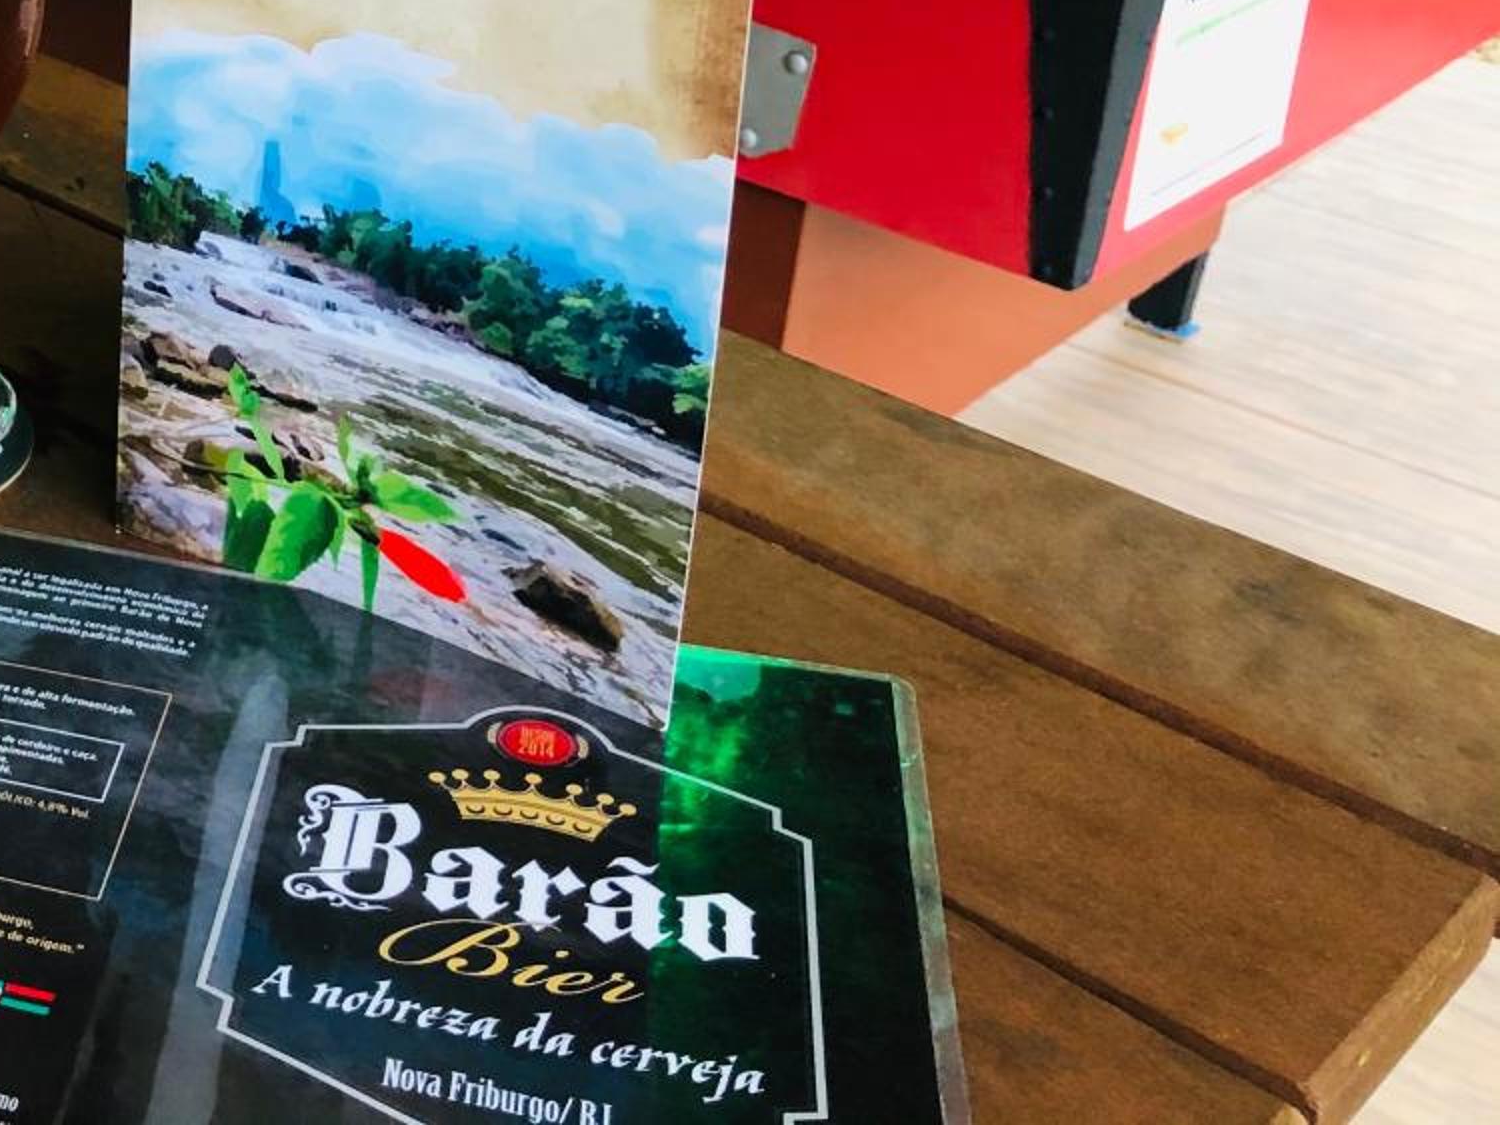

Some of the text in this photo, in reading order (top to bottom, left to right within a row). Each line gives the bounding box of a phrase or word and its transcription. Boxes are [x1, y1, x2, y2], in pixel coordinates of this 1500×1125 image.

[283, 783, 760, 962] Barão
[7, 930, 24, 942] de
[378, 918, 645, 1004] Bier
[252, 964, 767, 1105] A nobreza da cerveja
[381, 1056, 442, 1099] Nova
